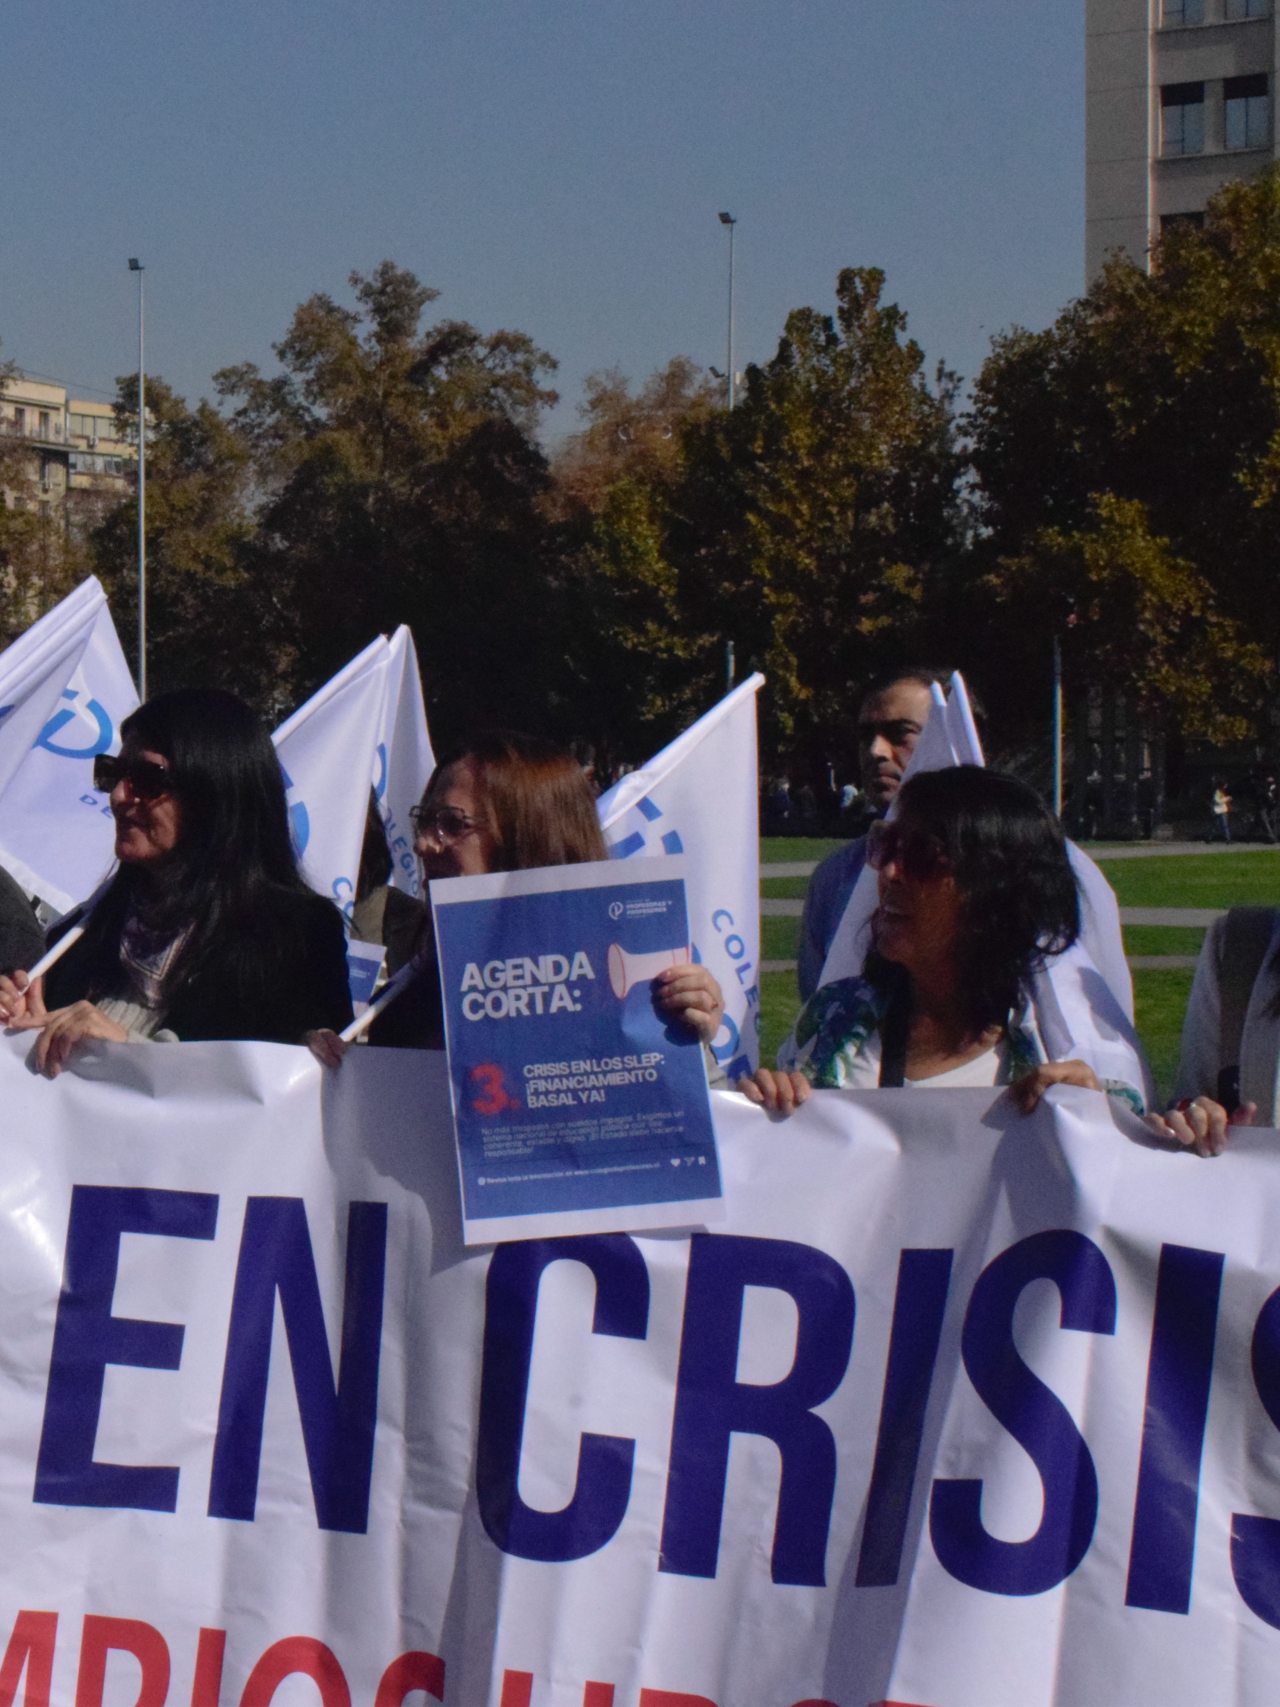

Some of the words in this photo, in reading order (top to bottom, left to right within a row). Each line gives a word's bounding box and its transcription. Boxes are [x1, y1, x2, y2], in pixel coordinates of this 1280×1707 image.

[460, 951, 596, 992] AGENDA
[462, 983, 582, 1021] CORTA:
[523, 1062, 570, 1078] CRISIS
[571, 1060, 592, 1075] EN
[592, 1057, 623, 1072] LOS
[623, 1052, 666, 1070] SLEP:
[527, 1092, 577, 1109] BASAL
[579, 1089, 606, 1103] YA!
[33, 1184, 388, 1535] EN
[476, 1229, 1280, 1632] CRISI
